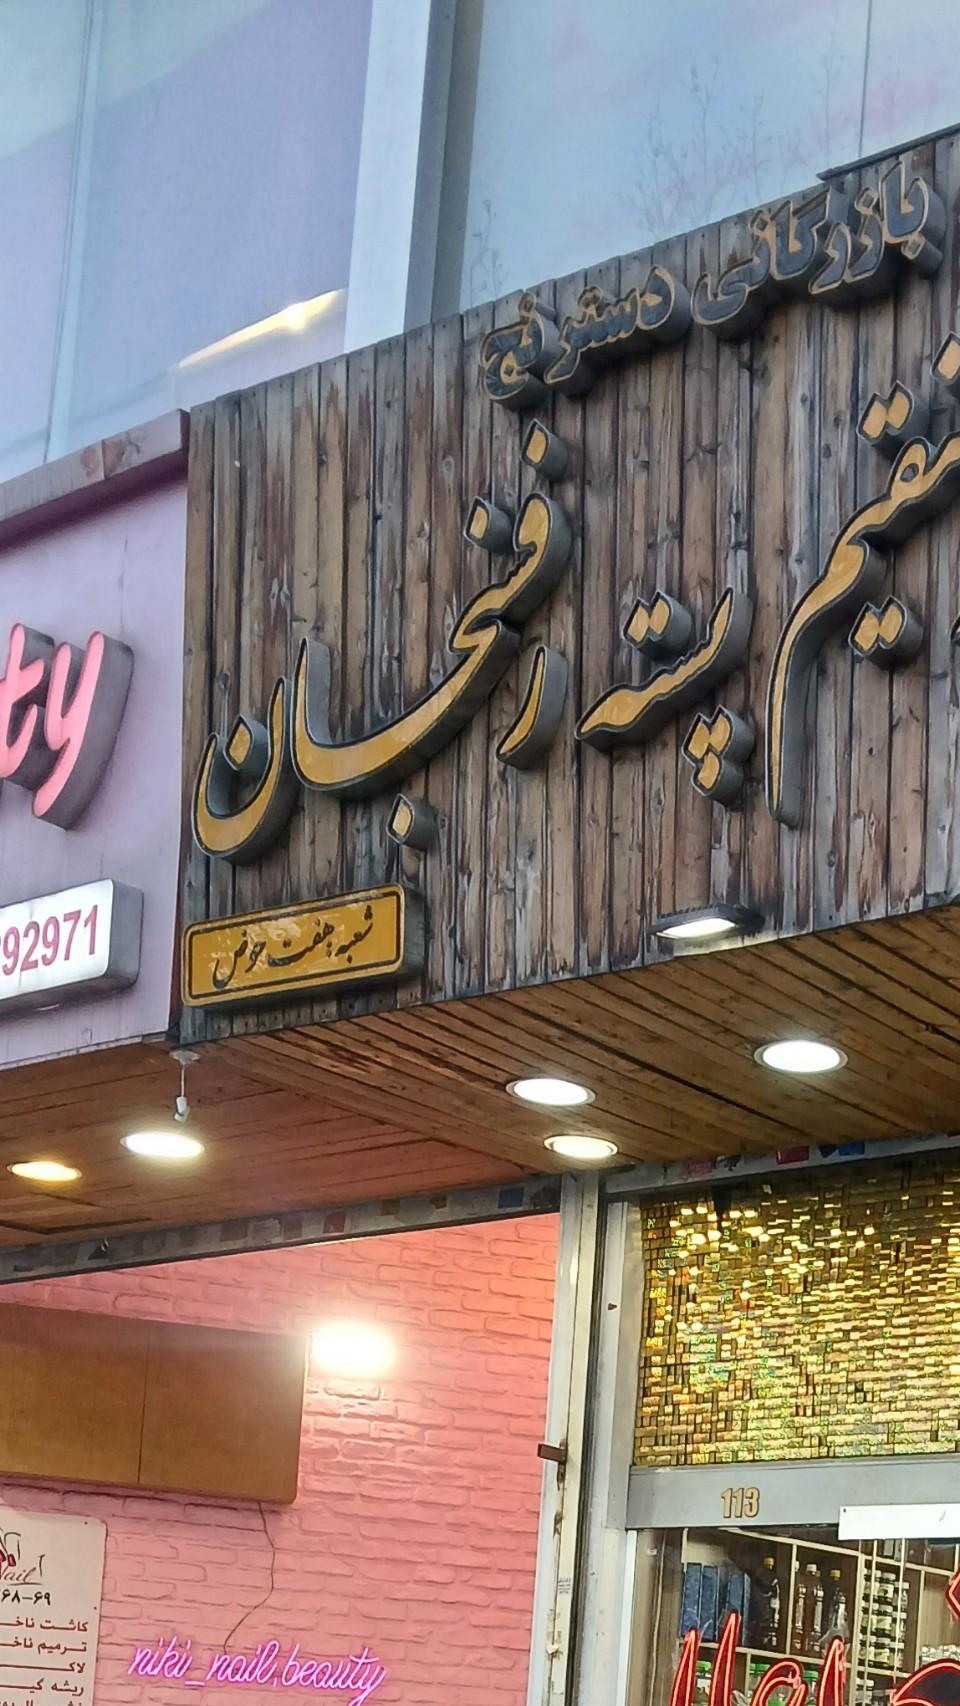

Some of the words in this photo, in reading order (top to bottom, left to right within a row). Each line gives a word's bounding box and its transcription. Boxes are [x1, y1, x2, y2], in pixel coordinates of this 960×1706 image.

[691, 161, 932, 327] بازرگانی
[480, 265, 676, 401] دسترنج
[195, 420, 565, 858] رفسنجان
[577, 587, 736, 797] پسته
[212, 929, 267, 990] حوض
[267, 917, 335, 968] هفت
[335, 904, 374, 964] شعبه
[720, 1487, 761, 1520] 113
